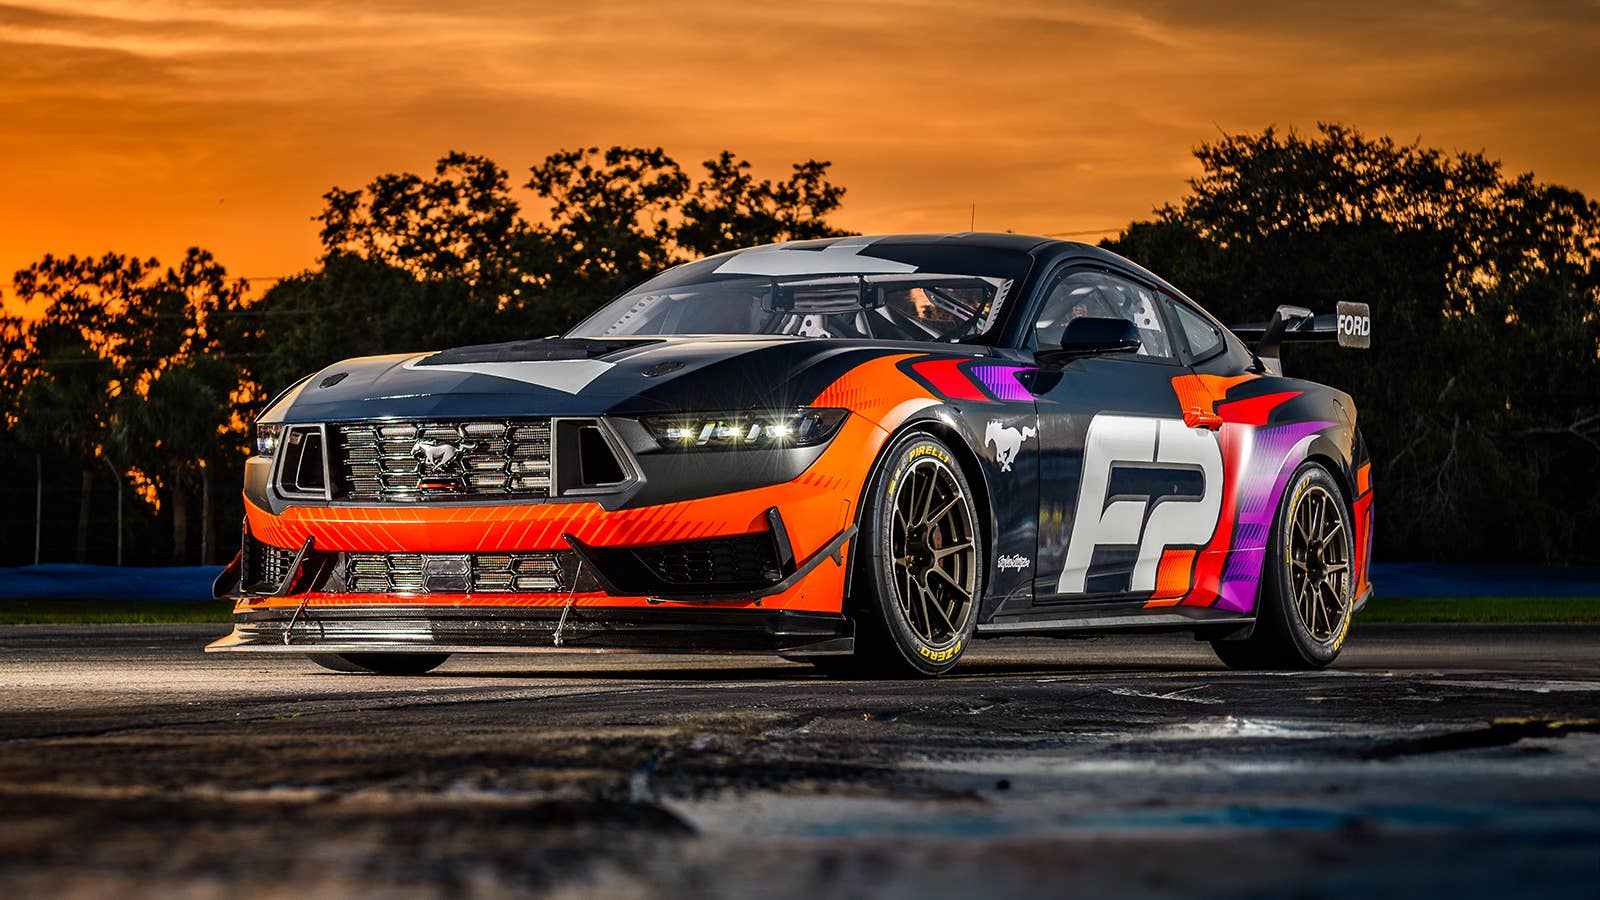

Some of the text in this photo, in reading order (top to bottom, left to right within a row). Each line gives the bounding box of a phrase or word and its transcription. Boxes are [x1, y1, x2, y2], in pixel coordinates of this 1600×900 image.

[1338, 314, 1370, 336] FORD
[909, 445, 949, 463] PIRELLI
[1057, 413, 1224, 594] FP
[920, 640, 961, 662] P ZERO
